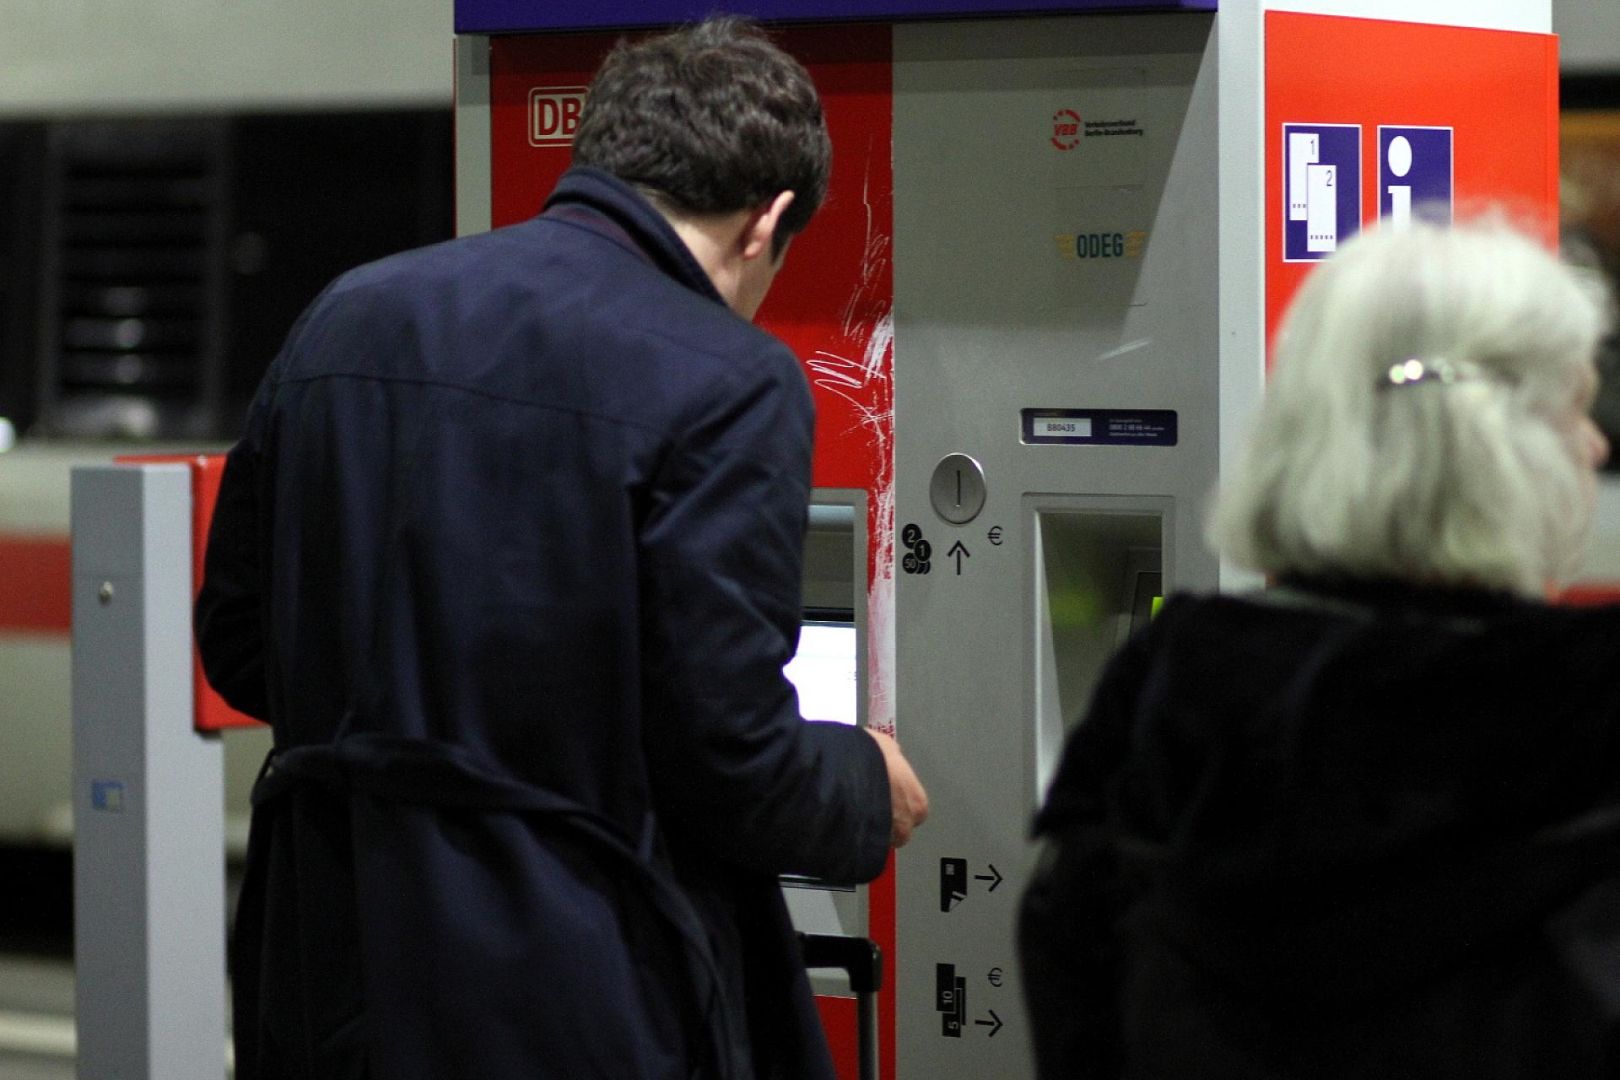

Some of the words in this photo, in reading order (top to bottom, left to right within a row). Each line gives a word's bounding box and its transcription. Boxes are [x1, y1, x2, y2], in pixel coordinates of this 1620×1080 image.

[538, 97, 582, 135] DB
[1326, 169, 1333, 187] 2
[1077, 233, 1124, 258] ODEG
[907, 528, 916, 544] 2
[920, 545, 926, 558] 1
